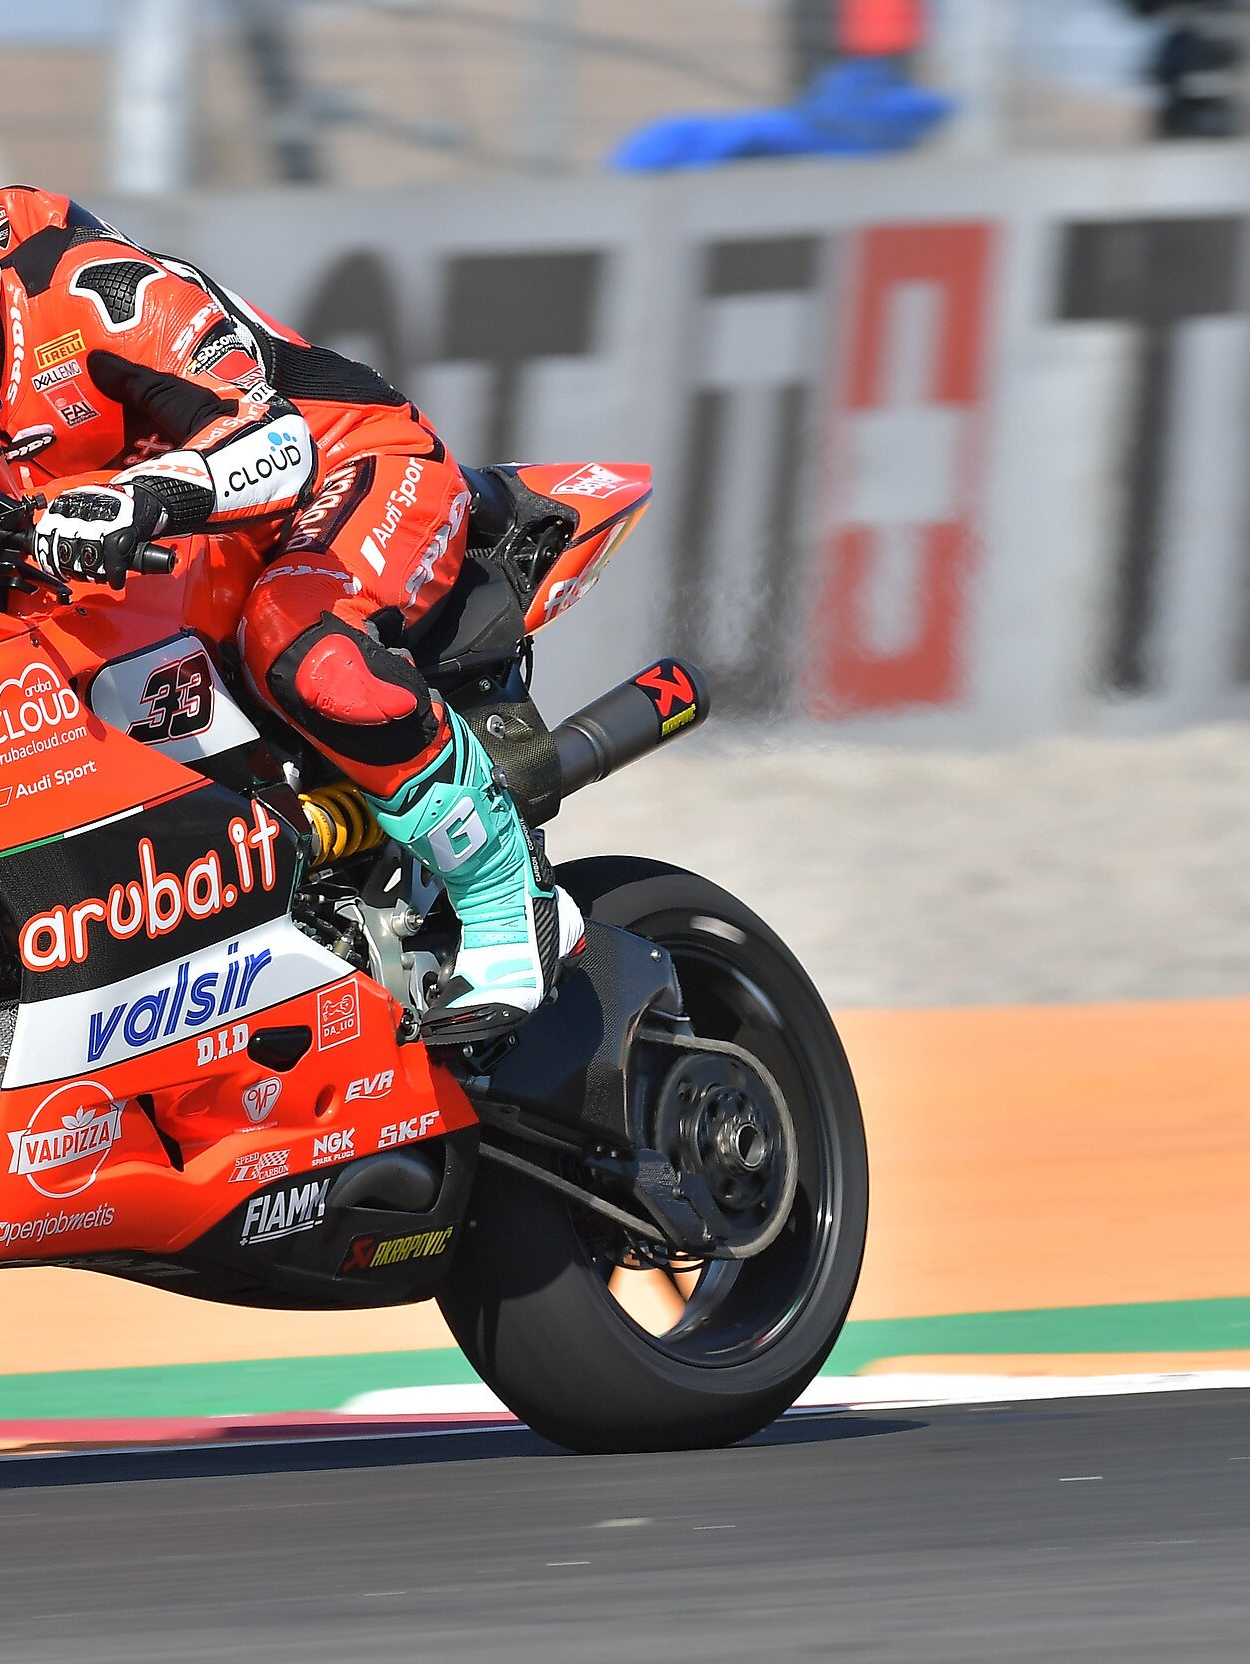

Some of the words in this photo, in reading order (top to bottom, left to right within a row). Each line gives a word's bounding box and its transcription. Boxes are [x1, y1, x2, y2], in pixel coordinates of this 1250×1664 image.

[36, 332, 84, 367] PIRELLI
[372, 501, 403, 549] Audi
[389, 457, 426, 508] Spor
[24, 677, 53, 699] aruba
[125, 649, 216, 747] 33
[15, 776, 52, 799] Audi
[53, 760, 98, 786] Sport
[19, 800, 281, 973] aruba.it
[531, 856, 542, 882] CARBON
[87, 942, 273, 1063] valsir
[346, 1070, 396, 1100] EVR
[26, 1120, 111, 1166] VALPIZZA
[313, 1127, 356, 1157] NGK
[377, 1111, 440, 1149] SKF
[235, 1152, 260, 1166] SPEED
[258, 1165, 290, 1180] CARBON
[311, 1156, 333, 1167] SPARK
[334, 1150, 355, 1161] PLUGS
[241, 1178, 331, 1238] FIAMM
